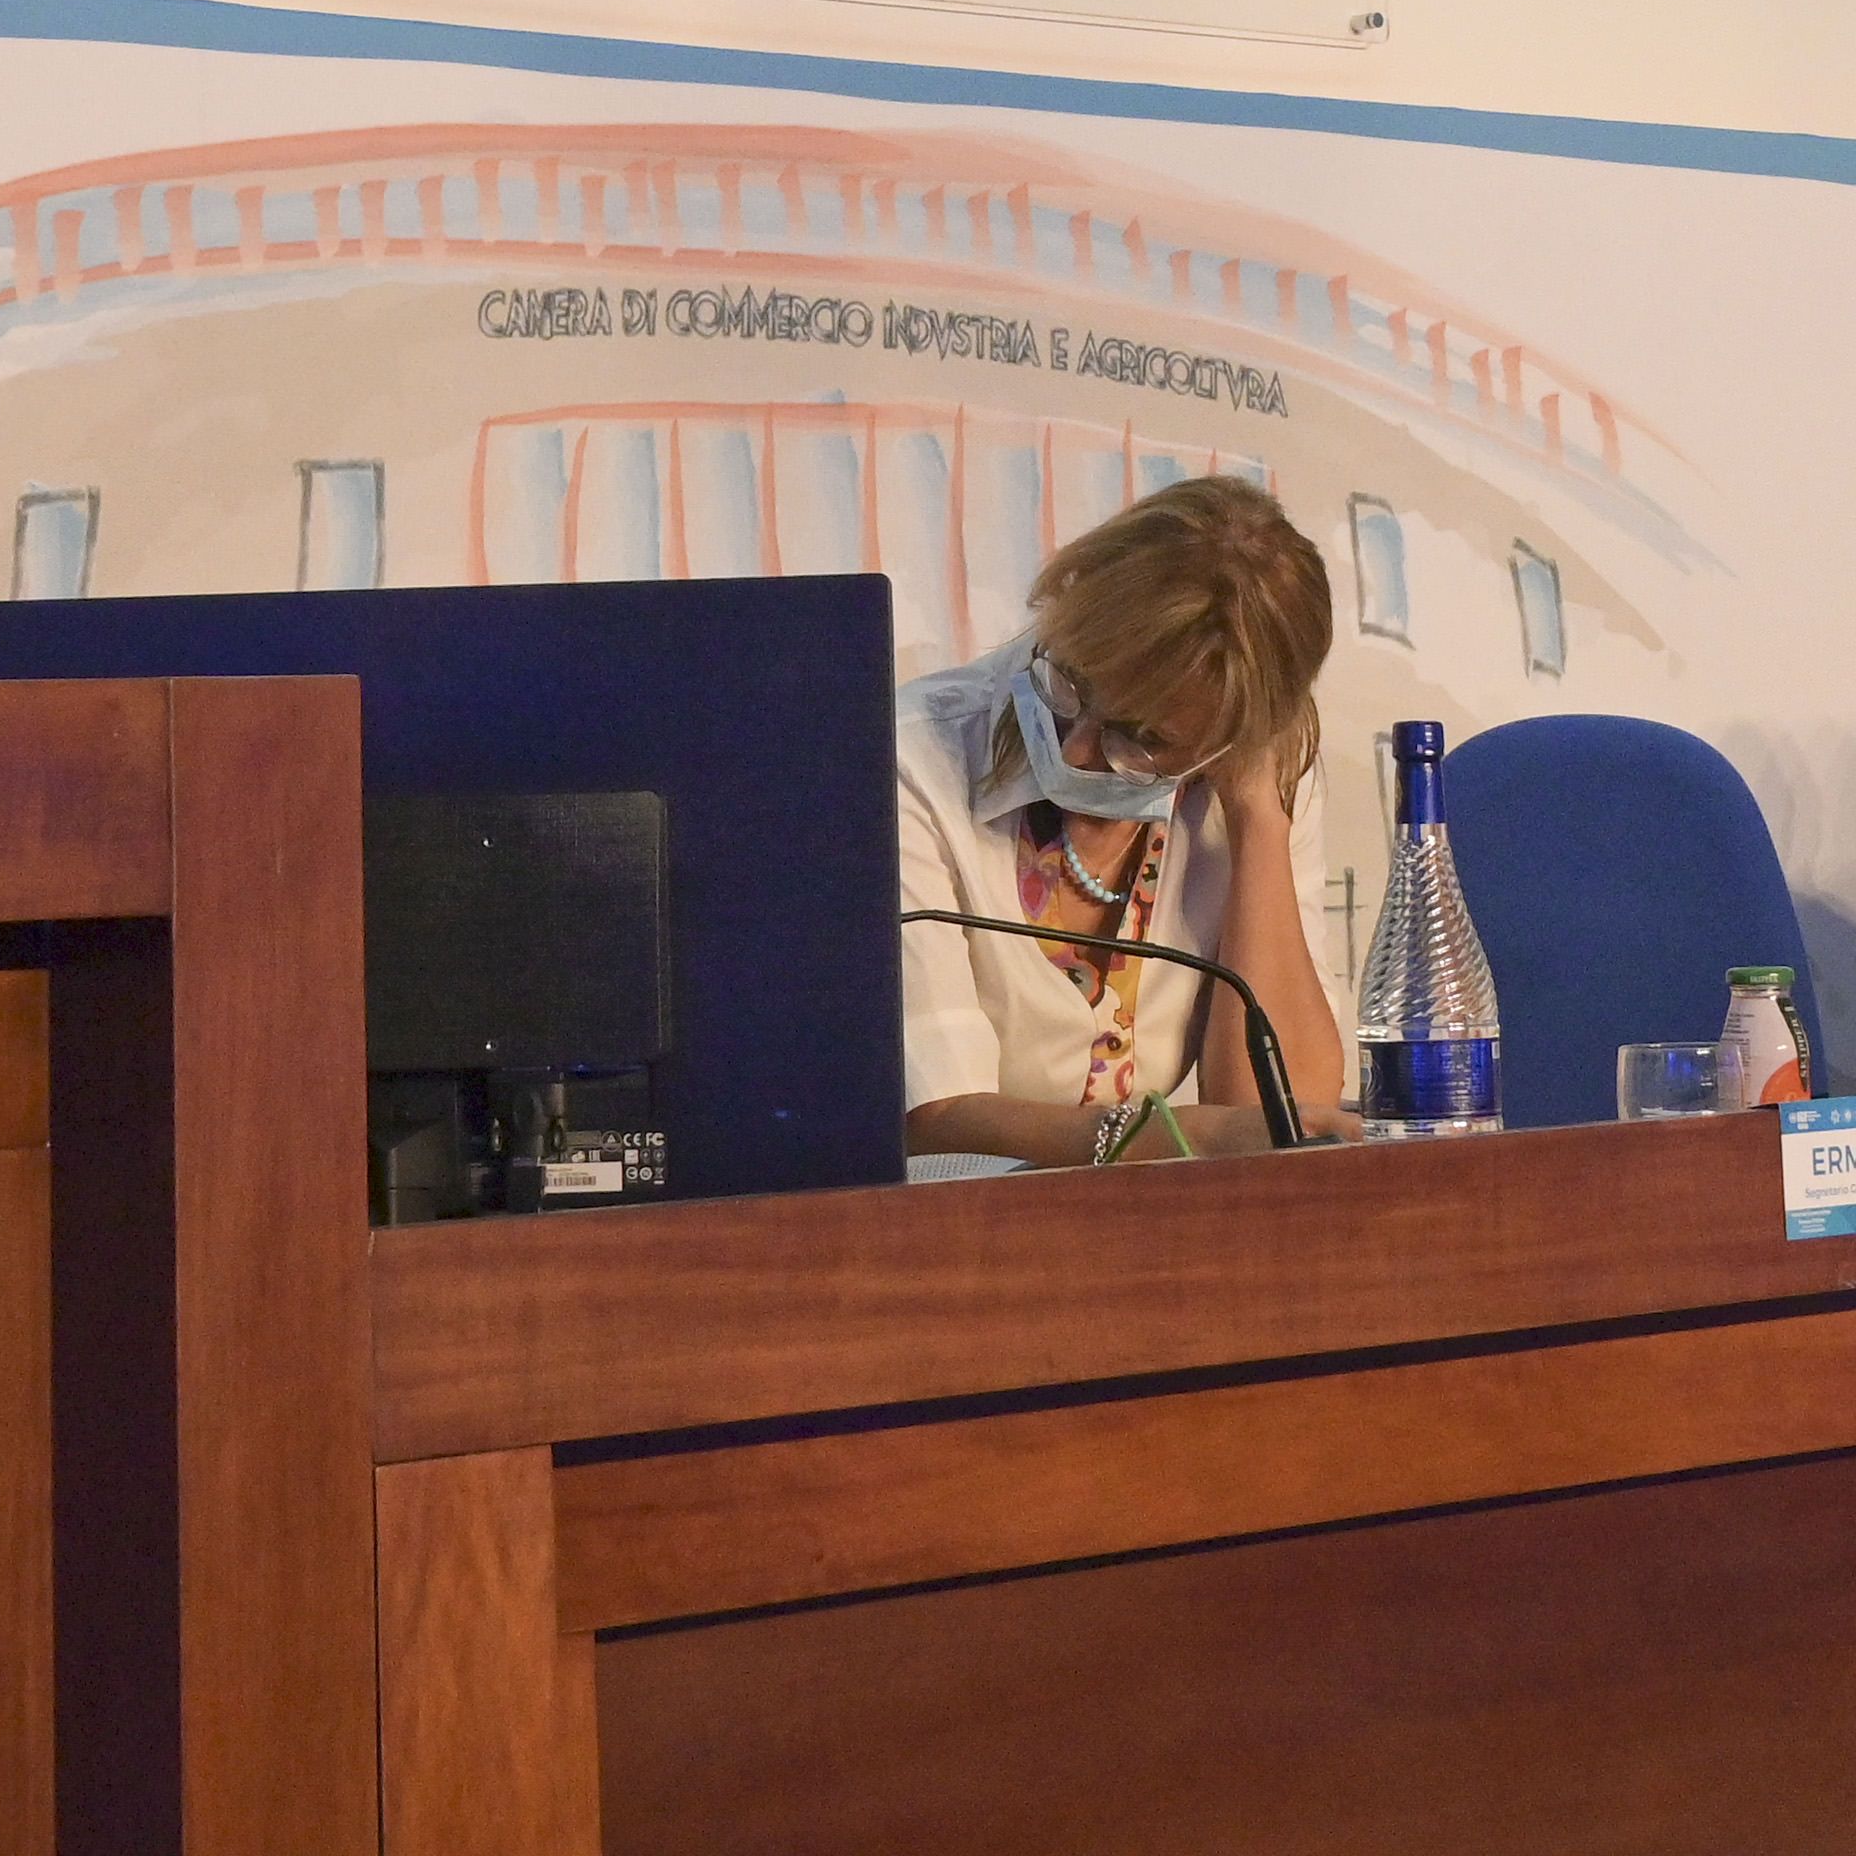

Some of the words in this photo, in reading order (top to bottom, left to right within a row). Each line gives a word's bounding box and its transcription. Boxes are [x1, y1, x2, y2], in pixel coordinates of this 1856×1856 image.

[478, 285, 612, 341] CAMERA
[621, 288, 657, 337] DI
[666, 284, 874, 347] COMMERCIO
[883, 298, 1041, 368] INDVSTRIA
[1050, 328, 1070, 371] E
[1077, 331, 1289, 418] AGRICOLTVRA
